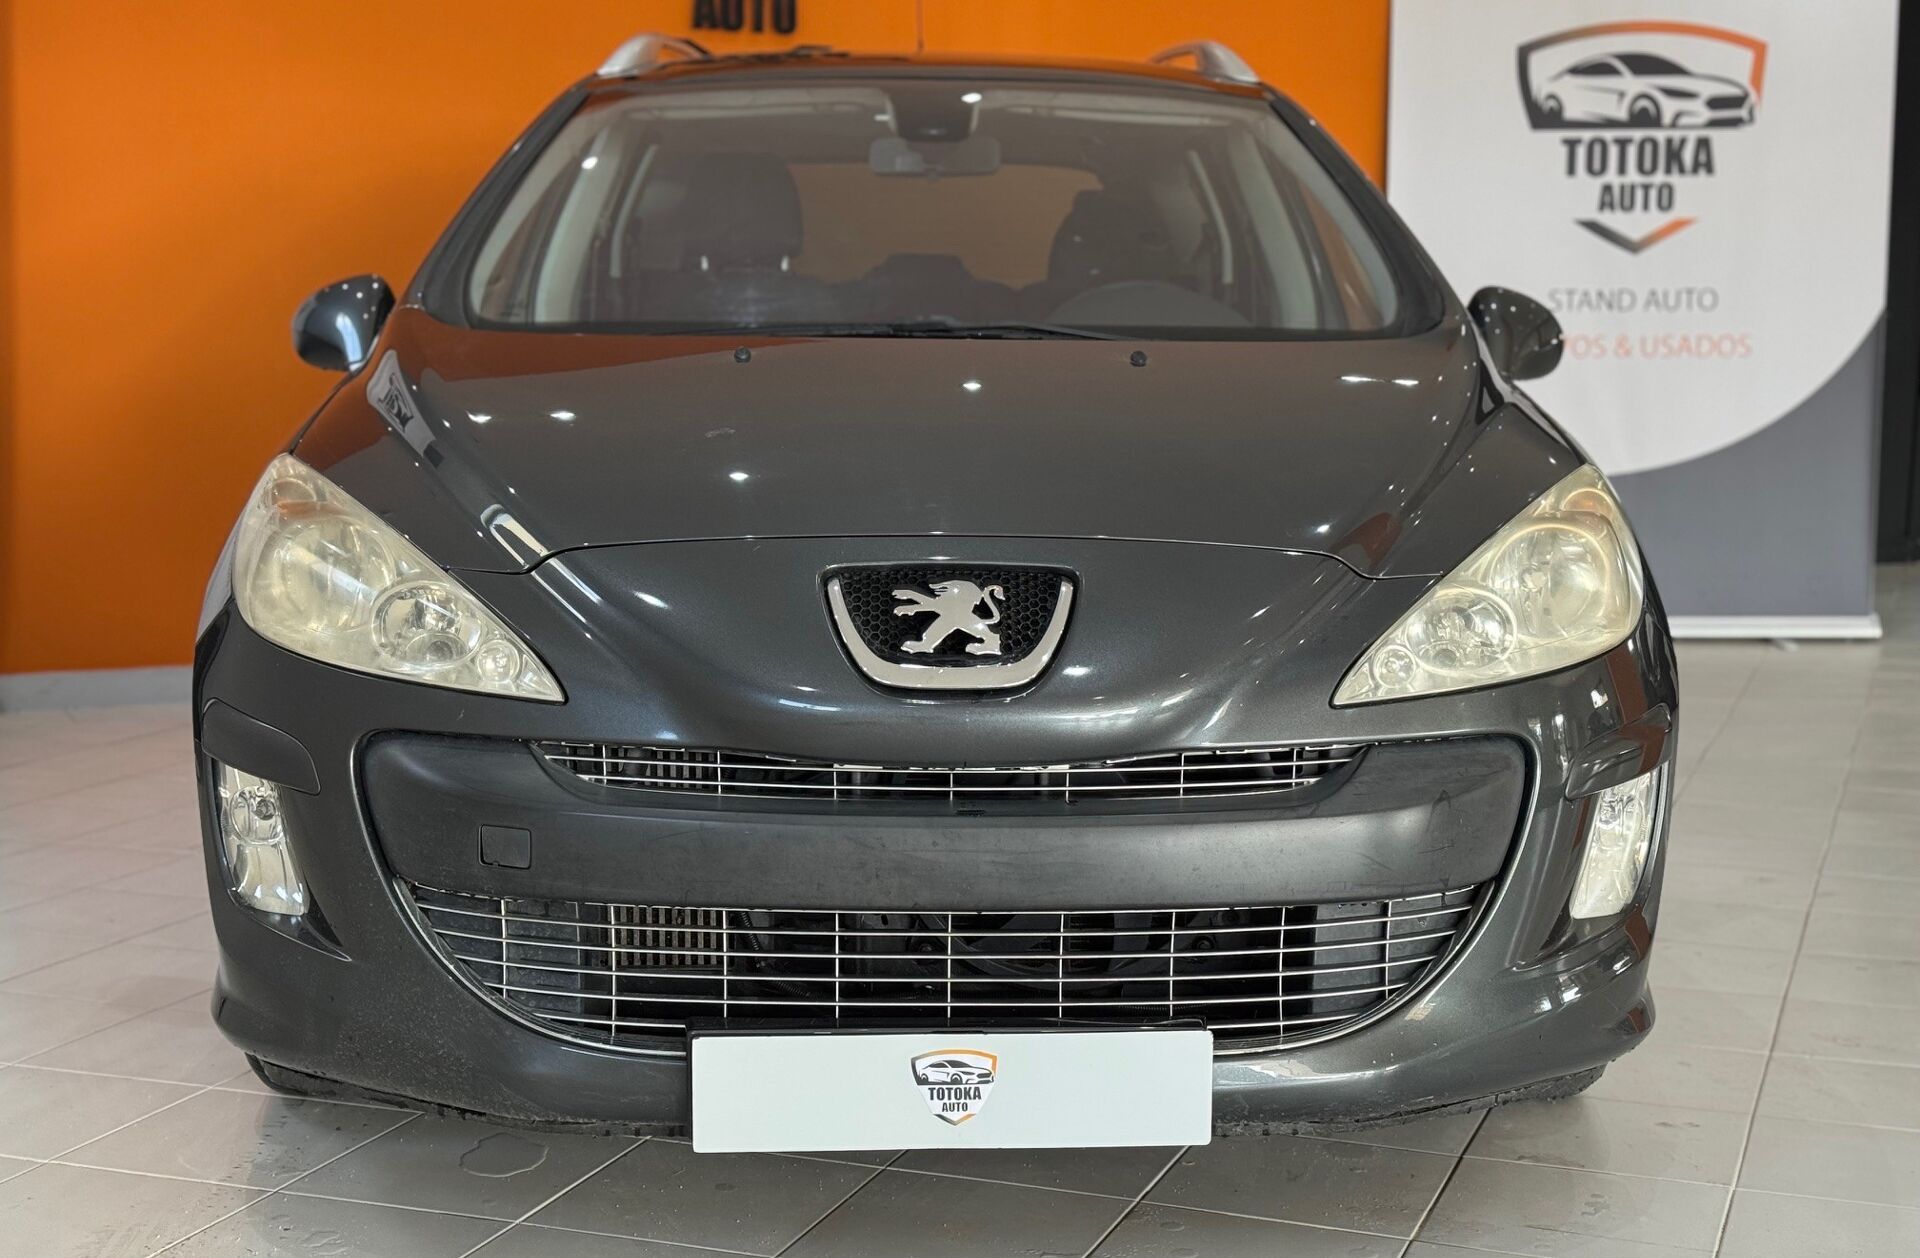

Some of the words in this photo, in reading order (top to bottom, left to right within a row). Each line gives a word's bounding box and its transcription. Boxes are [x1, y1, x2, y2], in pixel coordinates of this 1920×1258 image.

[1561, 137, 1715, 176] TOTOKA
[1597, 183, 1675, 212] AUTO
[1547, 288, 1637, 312] STAND
[1643, 287, 1719, 312] AUTO
[1639, 332, 1753, 359] USADOS
[928, 1087, 981, 1101] TOTOKA
[942, 1102, 968, 1112] AUTO
